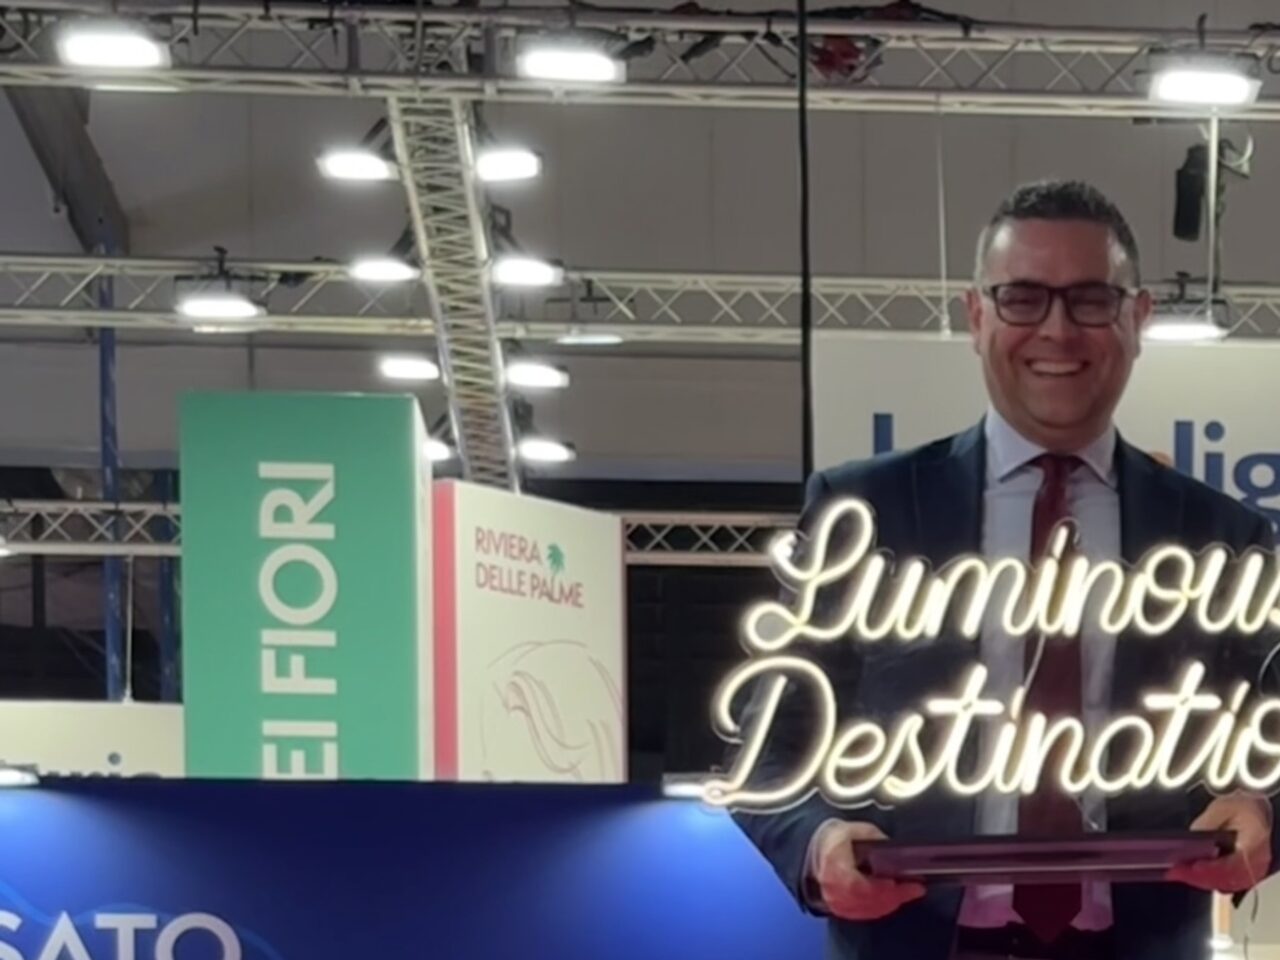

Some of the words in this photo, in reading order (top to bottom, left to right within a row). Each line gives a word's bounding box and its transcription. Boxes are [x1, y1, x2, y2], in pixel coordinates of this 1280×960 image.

[475, 526, 541, 565] RIVIERA
[259, 462, 337, 694] FIORI
[475, 563, 527, 597] DELLE
[530, 573, 584, 608] PALME
